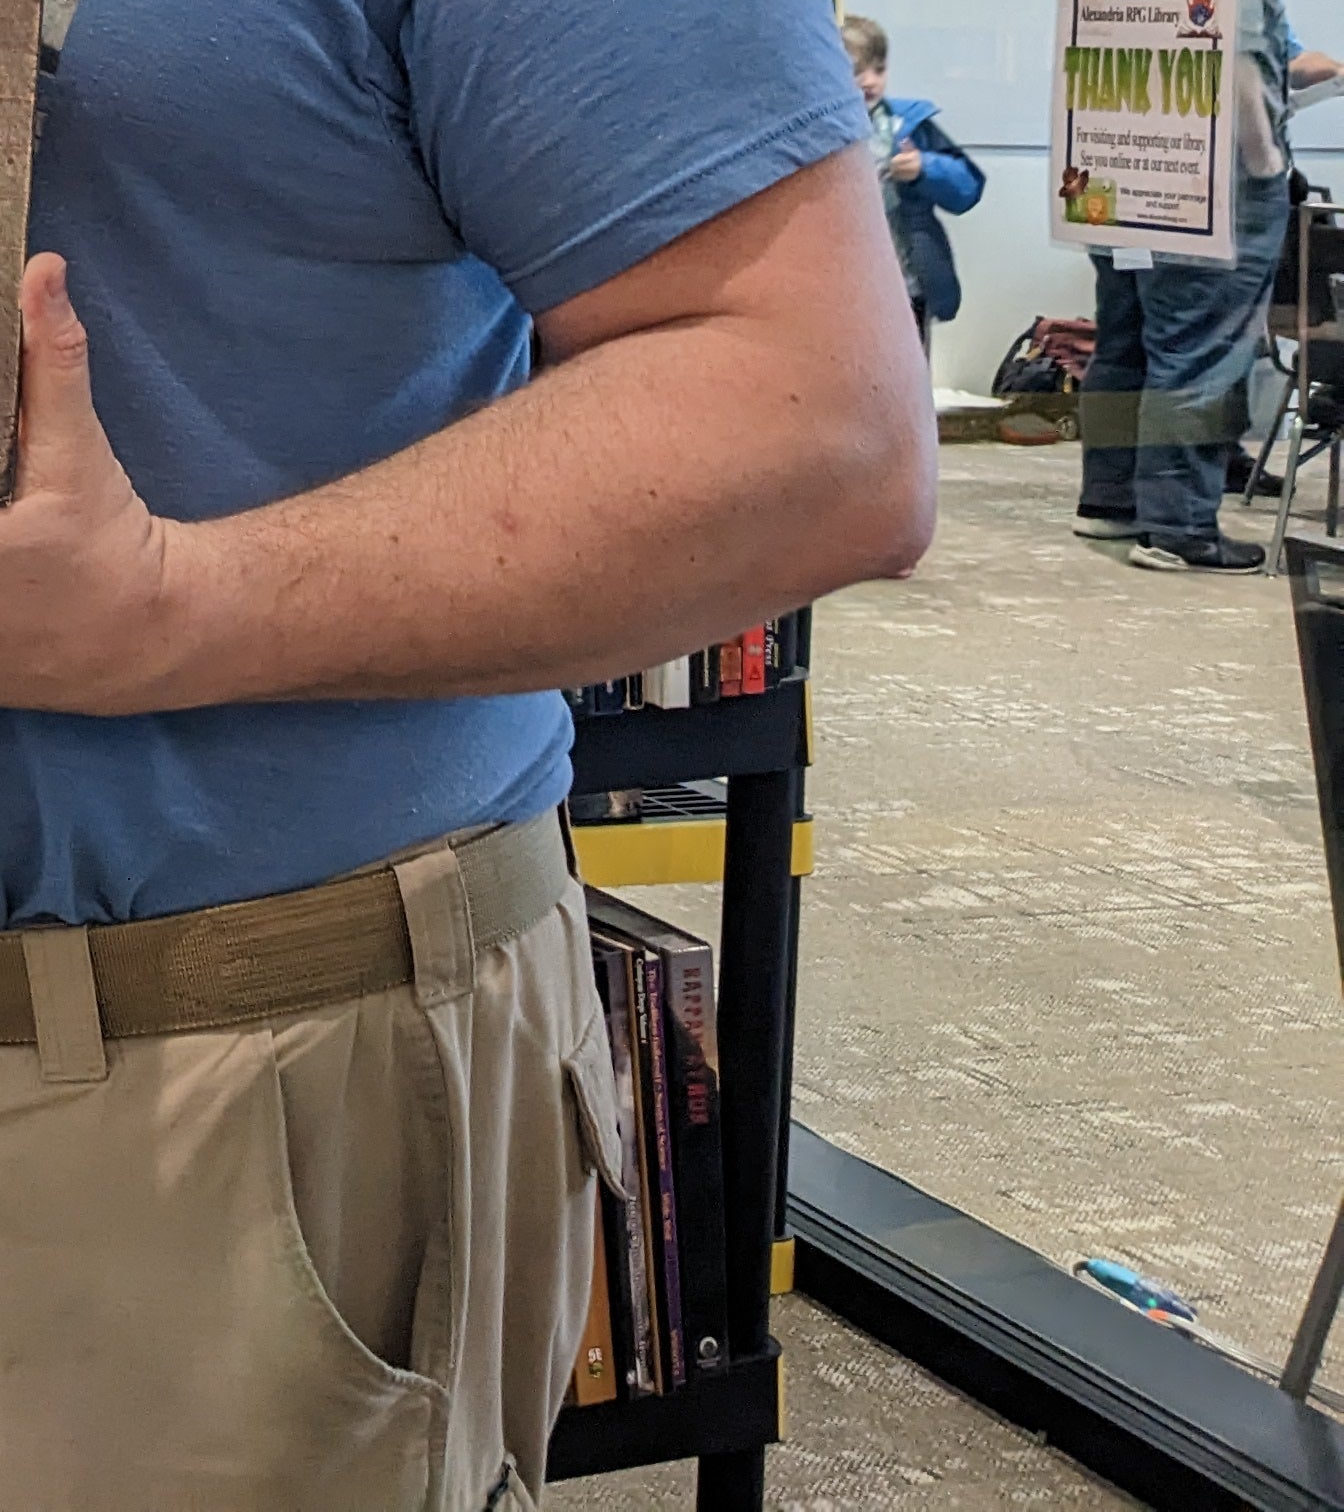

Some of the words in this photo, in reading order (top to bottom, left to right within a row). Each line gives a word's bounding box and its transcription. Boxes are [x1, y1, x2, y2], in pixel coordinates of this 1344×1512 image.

[1080, 5, 1124, 23] Alexandria
[1126, 6, 1146, 24] RPG
[1148, 7, 1180, 27] Library
[1064, 47, 1153, 116] THANK
[1159, 47, 1223, 117] YOU!
[1076, 128, 1088, 143] For
[1090, 130, 1115, 148] visiting
[1117, 131, 1130, 146] and
[1132, 133, 1168, 153] supporting
[1170, 137, 1182, 149] our
[1081, 150, 1092, 166] See
[1094, 155, 1107, 170] you
[1109, 153, 1132, 170] online
[1133, 158, 1140, 170] or
[1142, 157, 1149, 171] at
[1151, 160, 1162, 171] our
[1164, 159, 1178, 172] next
